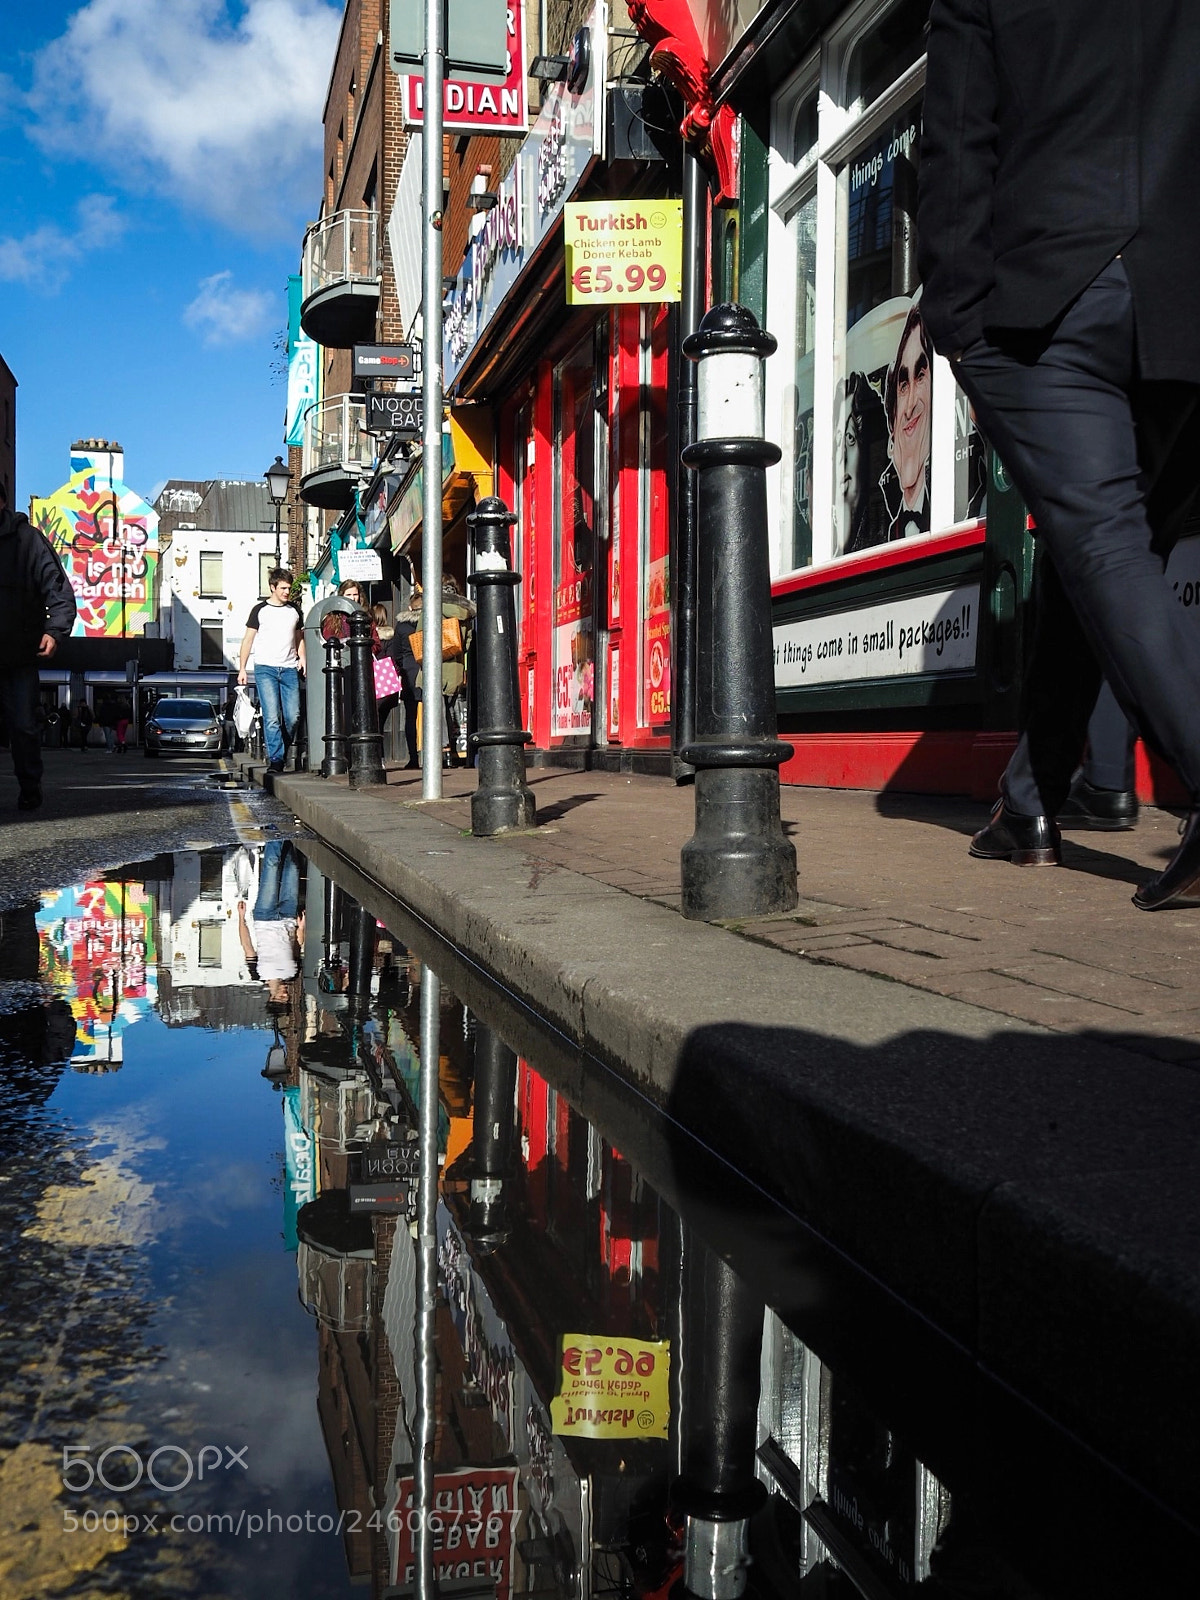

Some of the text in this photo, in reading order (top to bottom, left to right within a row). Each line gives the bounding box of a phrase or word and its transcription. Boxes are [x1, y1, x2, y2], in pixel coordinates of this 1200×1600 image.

[416, 82, 518, 115] IDIAN
[851, 151, 884, 193] things
[887, 124, 917, 163] come
[576, 212, 647, 231] Turkish
[574, 238, 662, 249] Chicken or Lamb
[583, 249, 653, 260] Doner Kebab
[572, 264, 667, 294] €5.99
[358, 354, 399, 367] GameStop
[103, 517, 147, 542] The
[87, 557, 107, 577] is
[783, 641, 813, 673] things
[817, 638, 844, 659] come
[847, 632, 859, 655] in
[863, 620, 894, 651] small
[899, 604, 971, 659] packages!!
